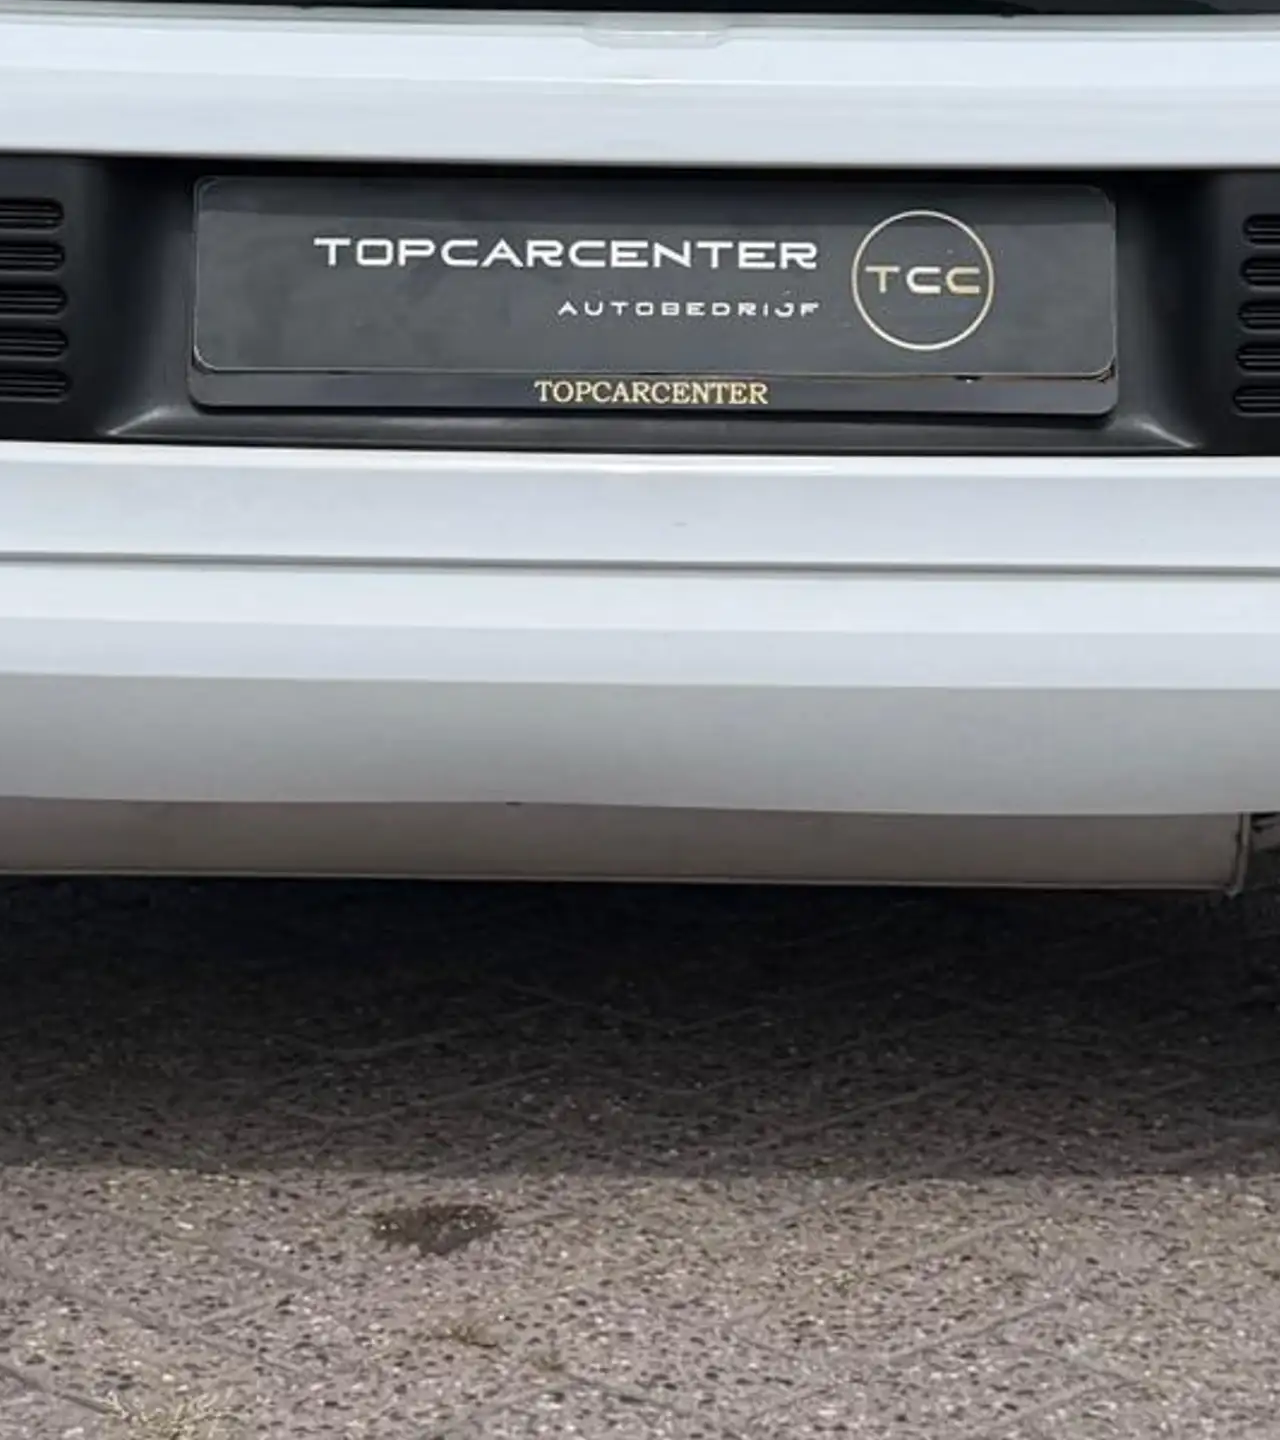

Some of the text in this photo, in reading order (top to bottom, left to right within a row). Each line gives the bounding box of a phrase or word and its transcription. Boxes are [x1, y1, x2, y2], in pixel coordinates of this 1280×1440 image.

[313, 236, 819, 271] TOPCARCENTER
[864, 264, 982, 296] TCC
[557, 299, 821, 318] AUTOBEDRIJF
[533, 379, 769, 406] TOPCARCENTER
